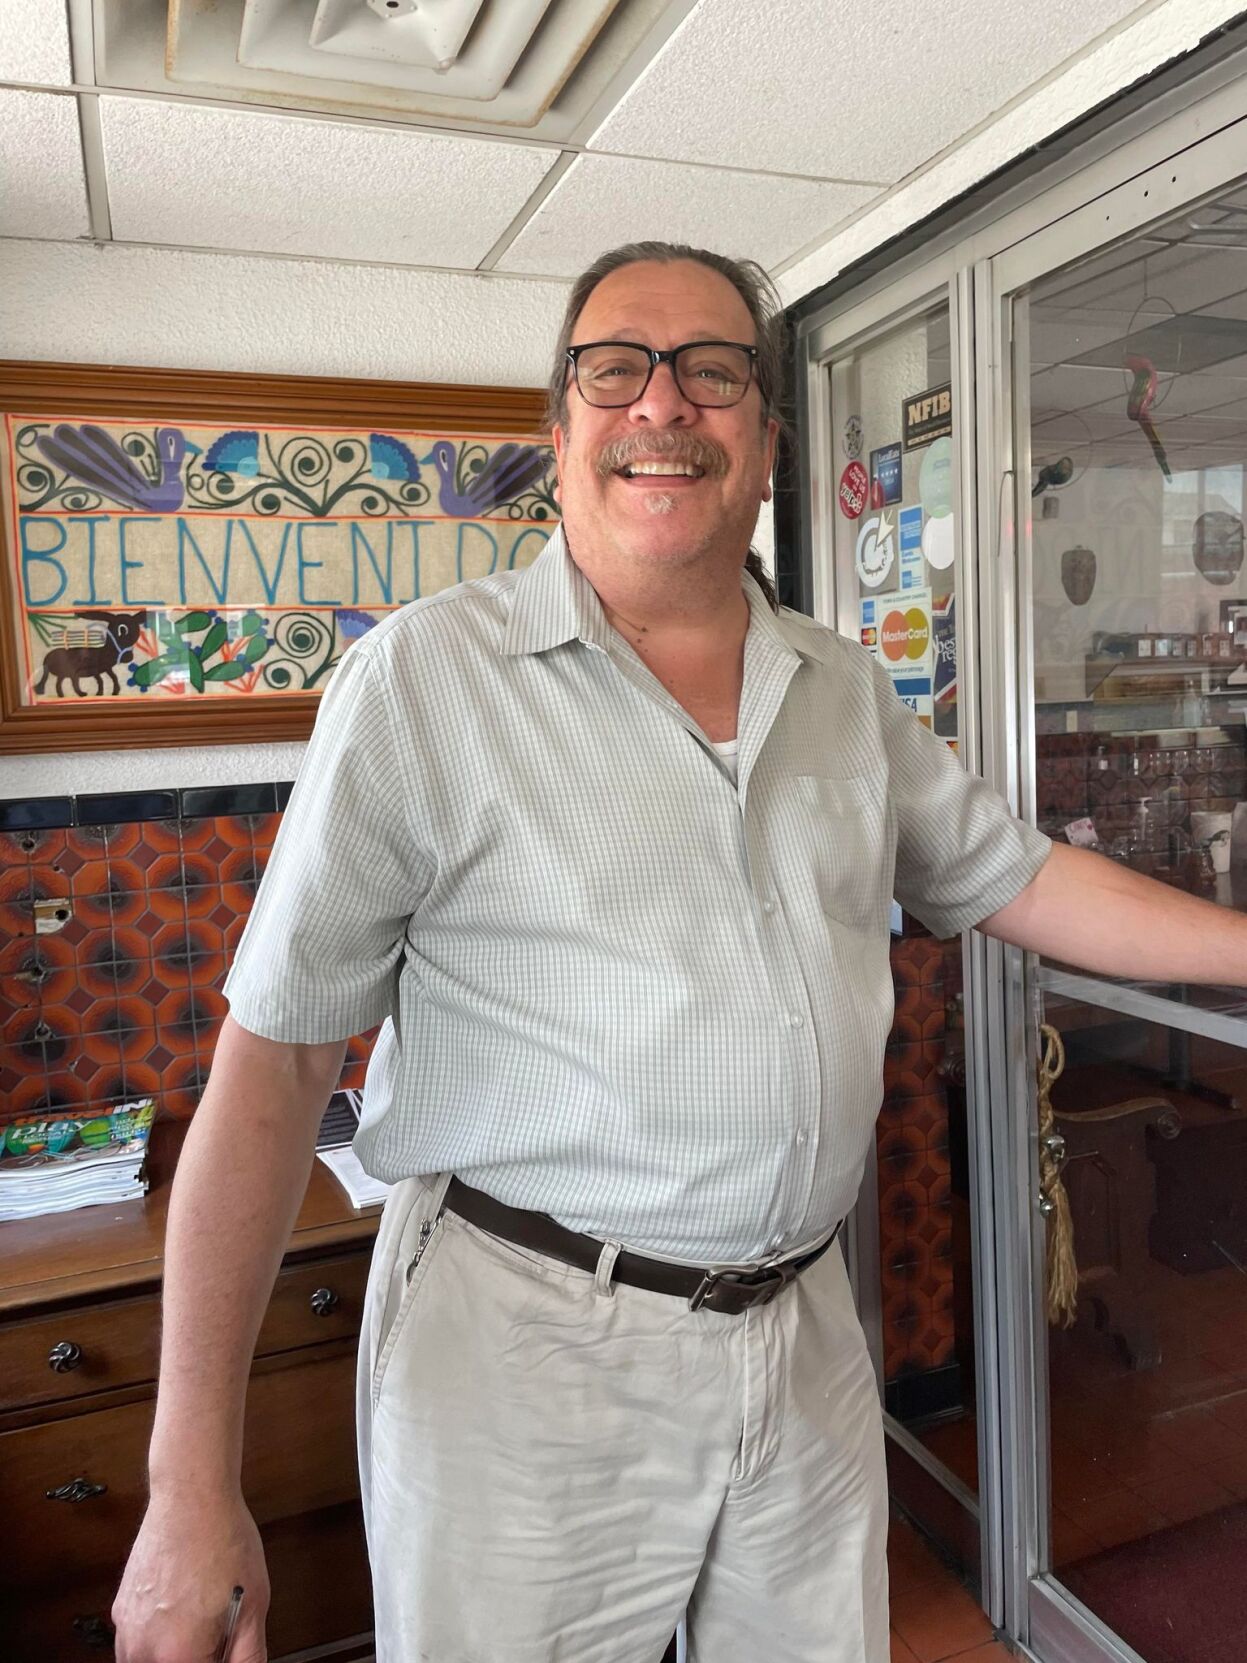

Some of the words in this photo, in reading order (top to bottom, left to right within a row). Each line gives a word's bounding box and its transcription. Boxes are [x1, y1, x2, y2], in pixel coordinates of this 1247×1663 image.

[907, 390, 951, 427] NFIB
[882, 627, 928, 643] MasterCard
[935, 635, 956, 654] bes
